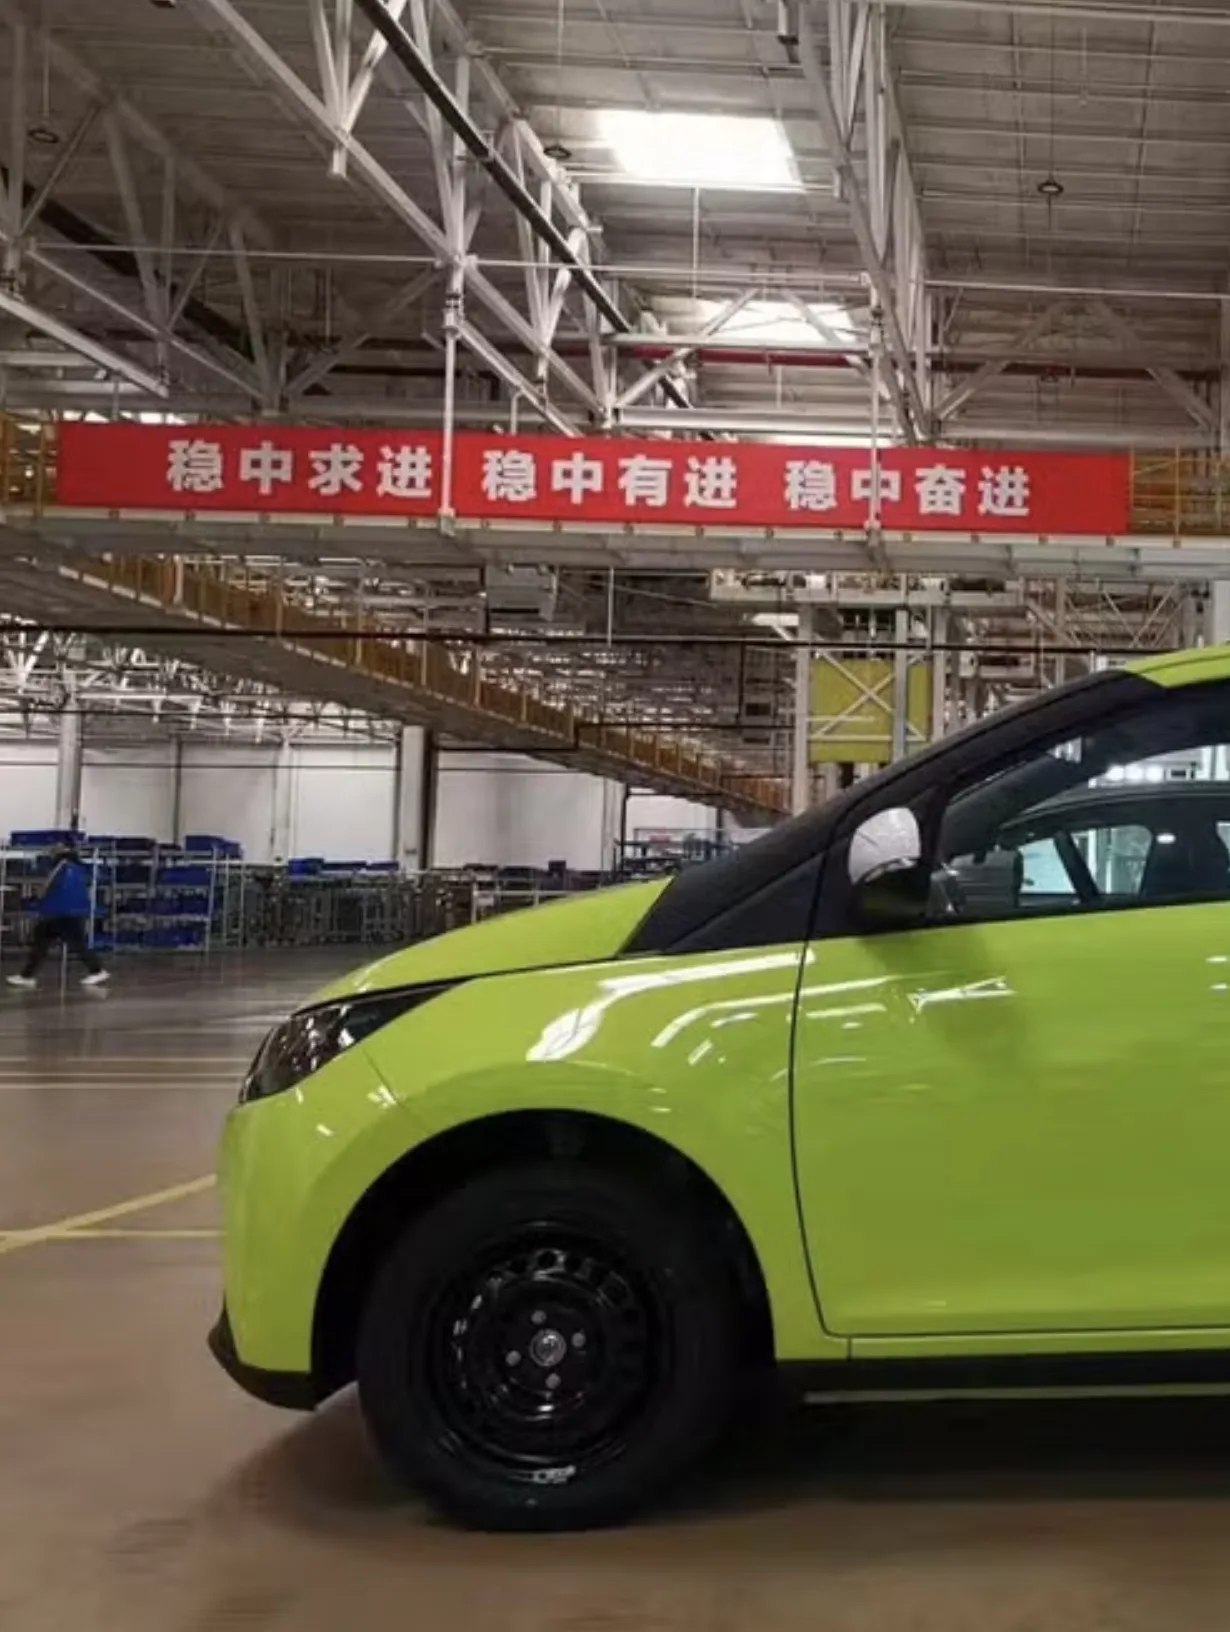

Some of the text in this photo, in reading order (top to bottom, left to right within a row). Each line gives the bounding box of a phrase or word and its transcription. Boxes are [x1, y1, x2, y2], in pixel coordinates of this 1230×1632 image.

[167, 440, 1030, 516] 稳中求进 稳中有进 稳中奋进
